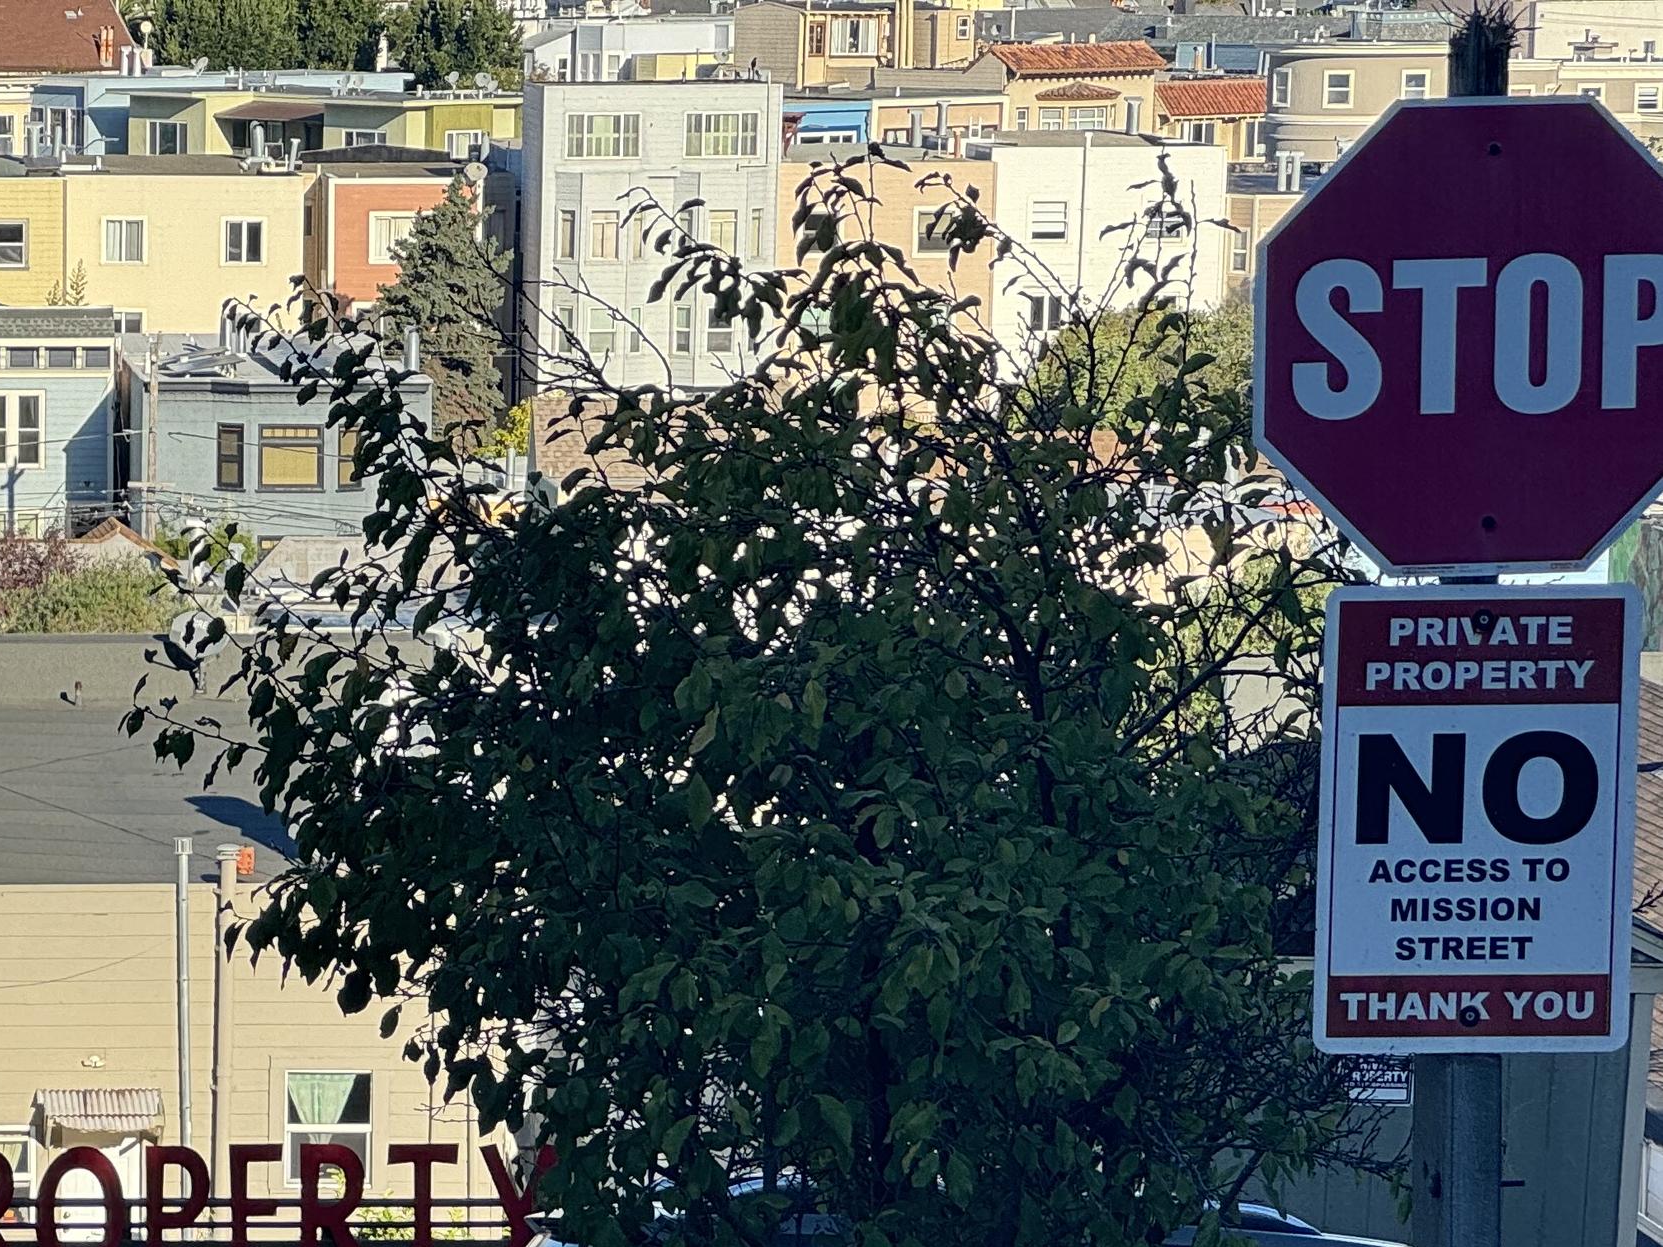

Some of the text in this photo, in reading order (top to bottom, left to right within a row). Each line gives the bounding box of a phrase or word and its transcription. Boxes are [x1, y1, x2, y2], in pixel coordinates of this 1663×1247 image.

[1292, 252, 1663, 420] STOP
[1389, 616, 1573, 647] PRIVATE
[1366, 660, 1594, 691] PROPERTY
[1355, 730, 1599, 845] NO
[1369, 858, 1570, 884] ACCESS TO
[1390, 897, 1541, 922] MISSION
[1395, 936, 1534, 962] STREET
[1340, 990, 1595, 1022] THANK YOU
